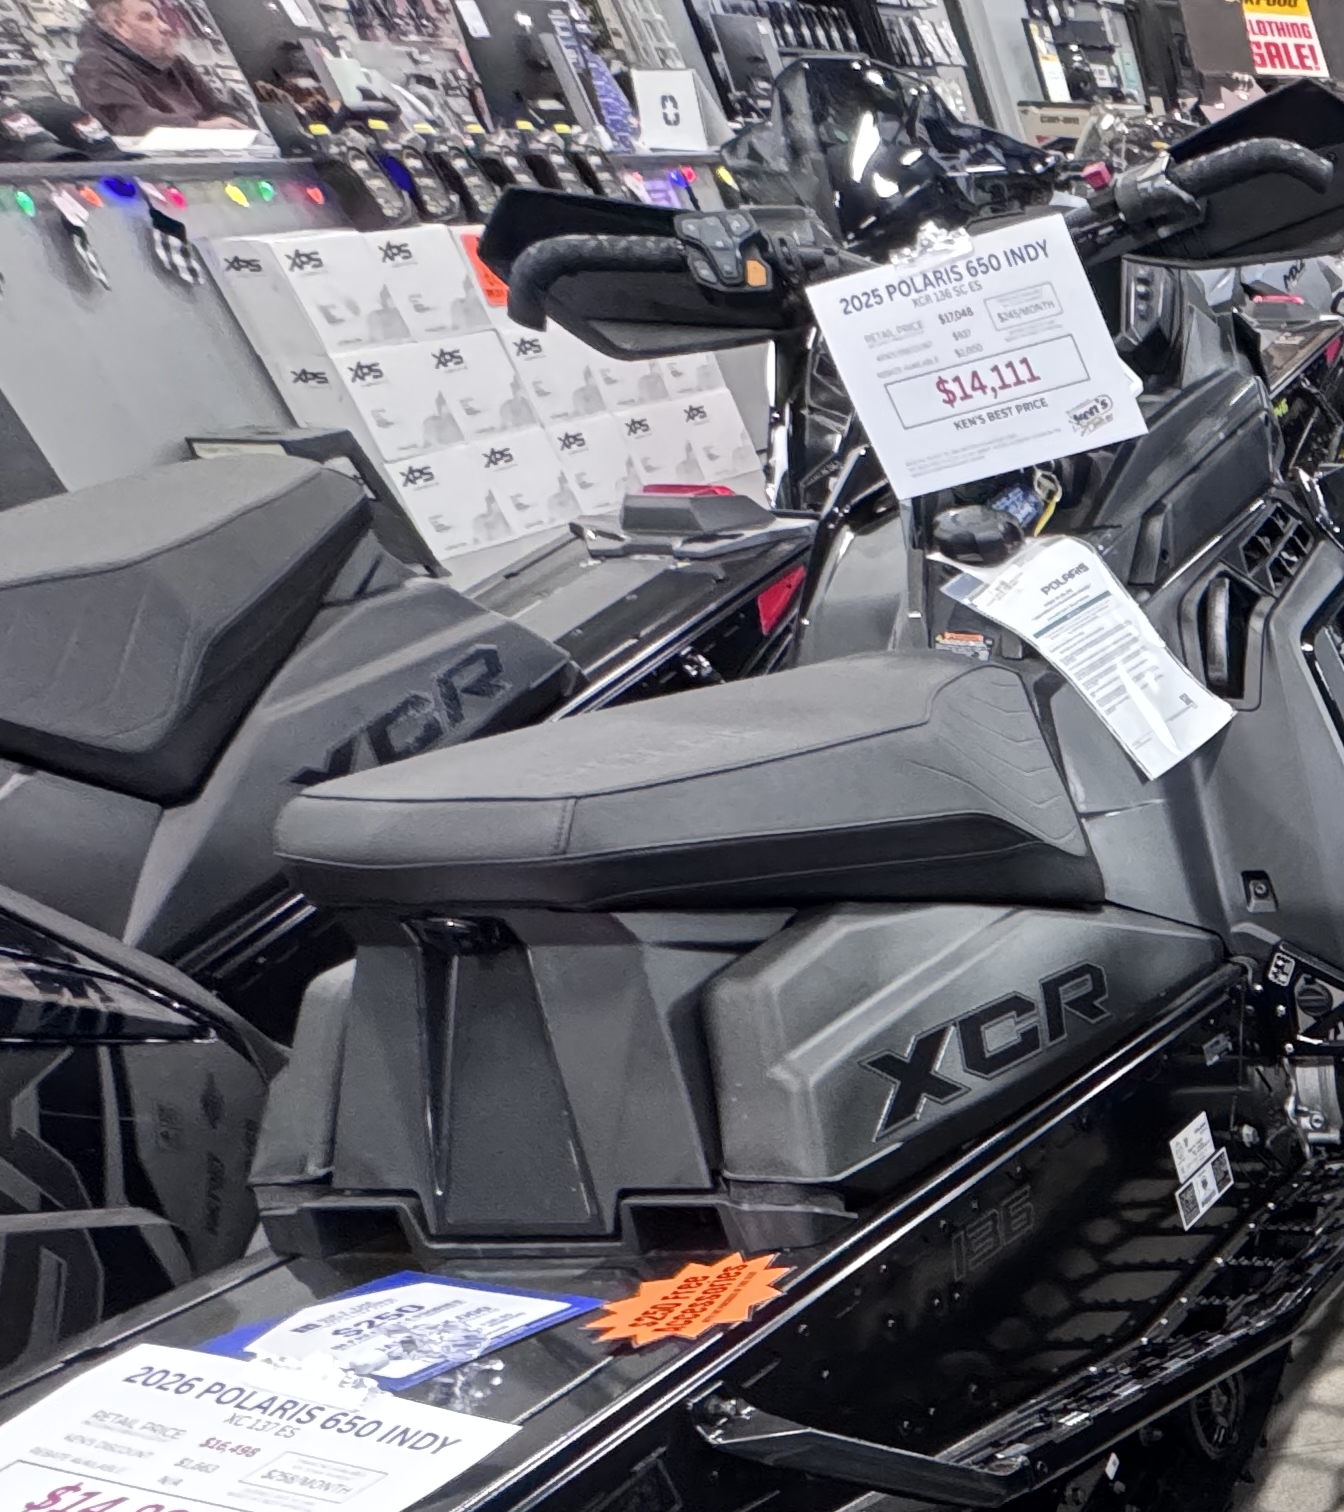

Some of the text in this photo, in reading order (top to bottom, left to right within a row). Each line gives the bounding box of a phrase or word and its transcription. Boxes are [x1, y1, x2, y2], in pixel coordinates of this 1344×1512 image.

[1247, 19, 1313, 39] LOTHING
[1252, 41, 1321, 71] SALE!
[287, 249, 324, 273] XPS
[380, 241, 413, 263] XPS
[224, 256, 262, 273] XPS
[840, 289, 884, 316] 2025
[885, 265, 963, 301] POLARIS
[966, 254, 1001, 278] 650
[1006, 239, 1050, 268] INDY
[968, 280, 984, 293] ES
[434, 349, 465, 369] XPS
[515, 338, 543, 356] XPS
[292, 368, 329, 384] XPS
[349, 361, 384, 383] XPS
[936, 357, 1041, 408] $14,111
[953, 397, 1049, 431] KEN'S BEST PRICE
[482, 447, 514, 468] XPS
[400, 465, 434, 487] XPS
[1040, 562, 1090, 596] POLARIS
[857, 959, 1111, 1143] XCR
[651, 1263, 749, 1334] Accessories
[660, 1274, 711, 1301] Free
[122, 1366, 462, 1456] 2026 POLARIS 650 INDY
[223, 1413, 301, 1439] XC 137 ES
